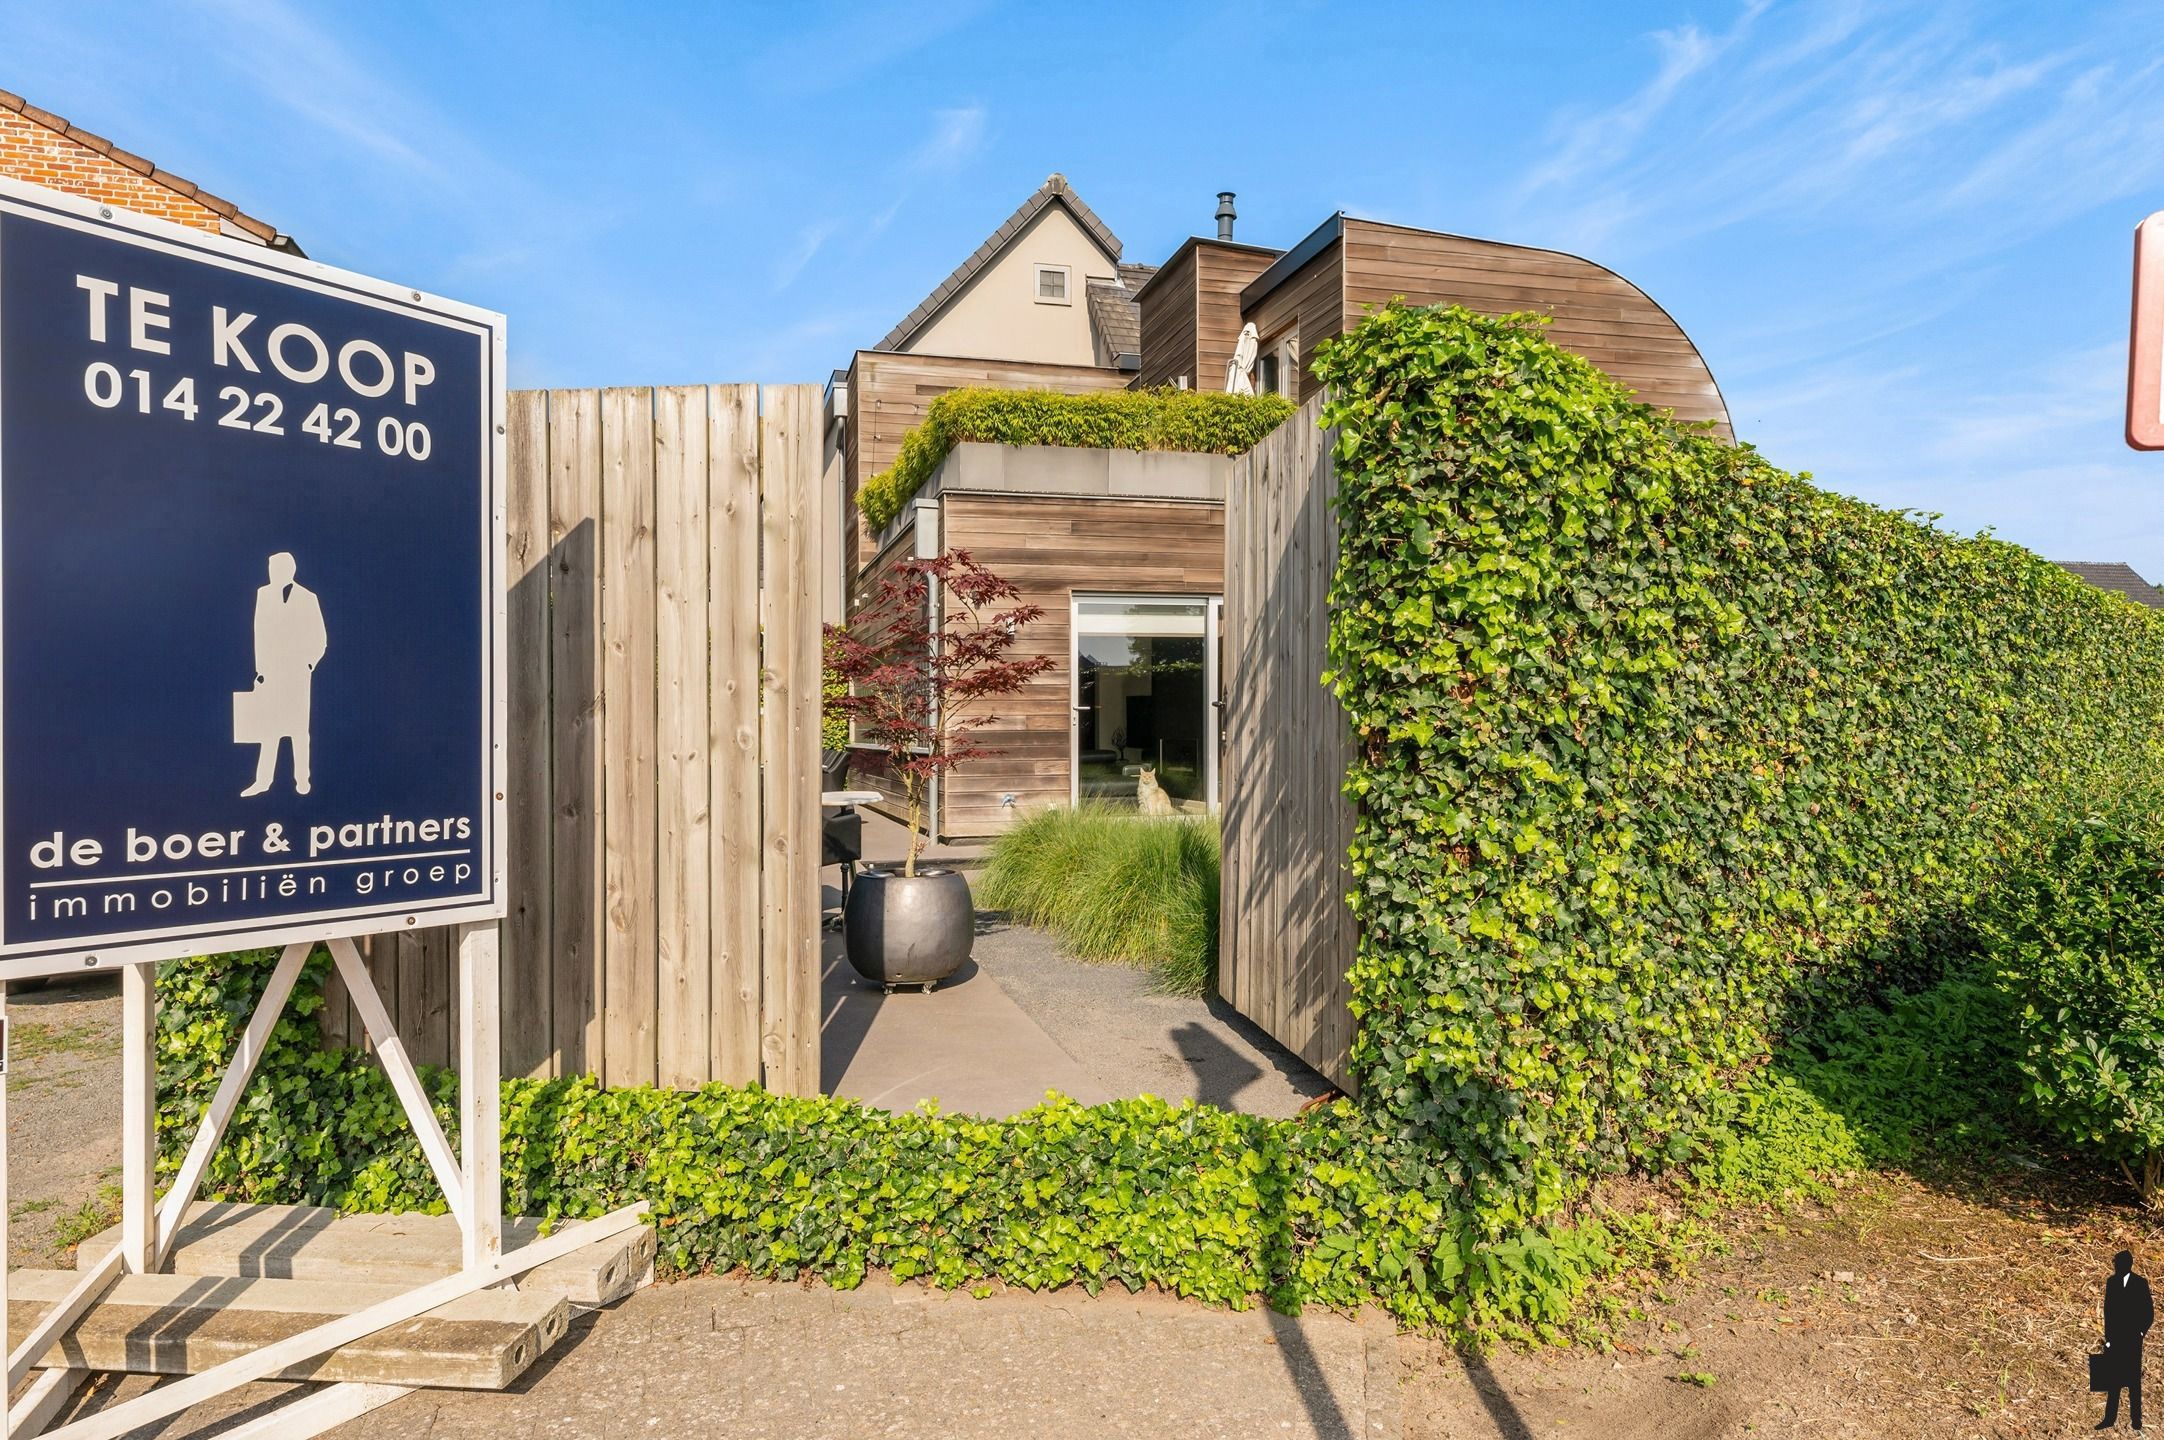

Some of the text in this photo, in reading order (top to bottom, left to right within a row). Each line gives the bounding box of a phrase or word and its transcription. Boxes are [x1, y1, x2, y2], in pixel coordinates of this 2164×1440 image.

[75, 273, 436, 406] TE KOOP
[84, 361, 432, 461] 014 22 42 00
[29, 814, 471, 869] de boer & partners
[29, 862, 471, 921] immobiliën groep
